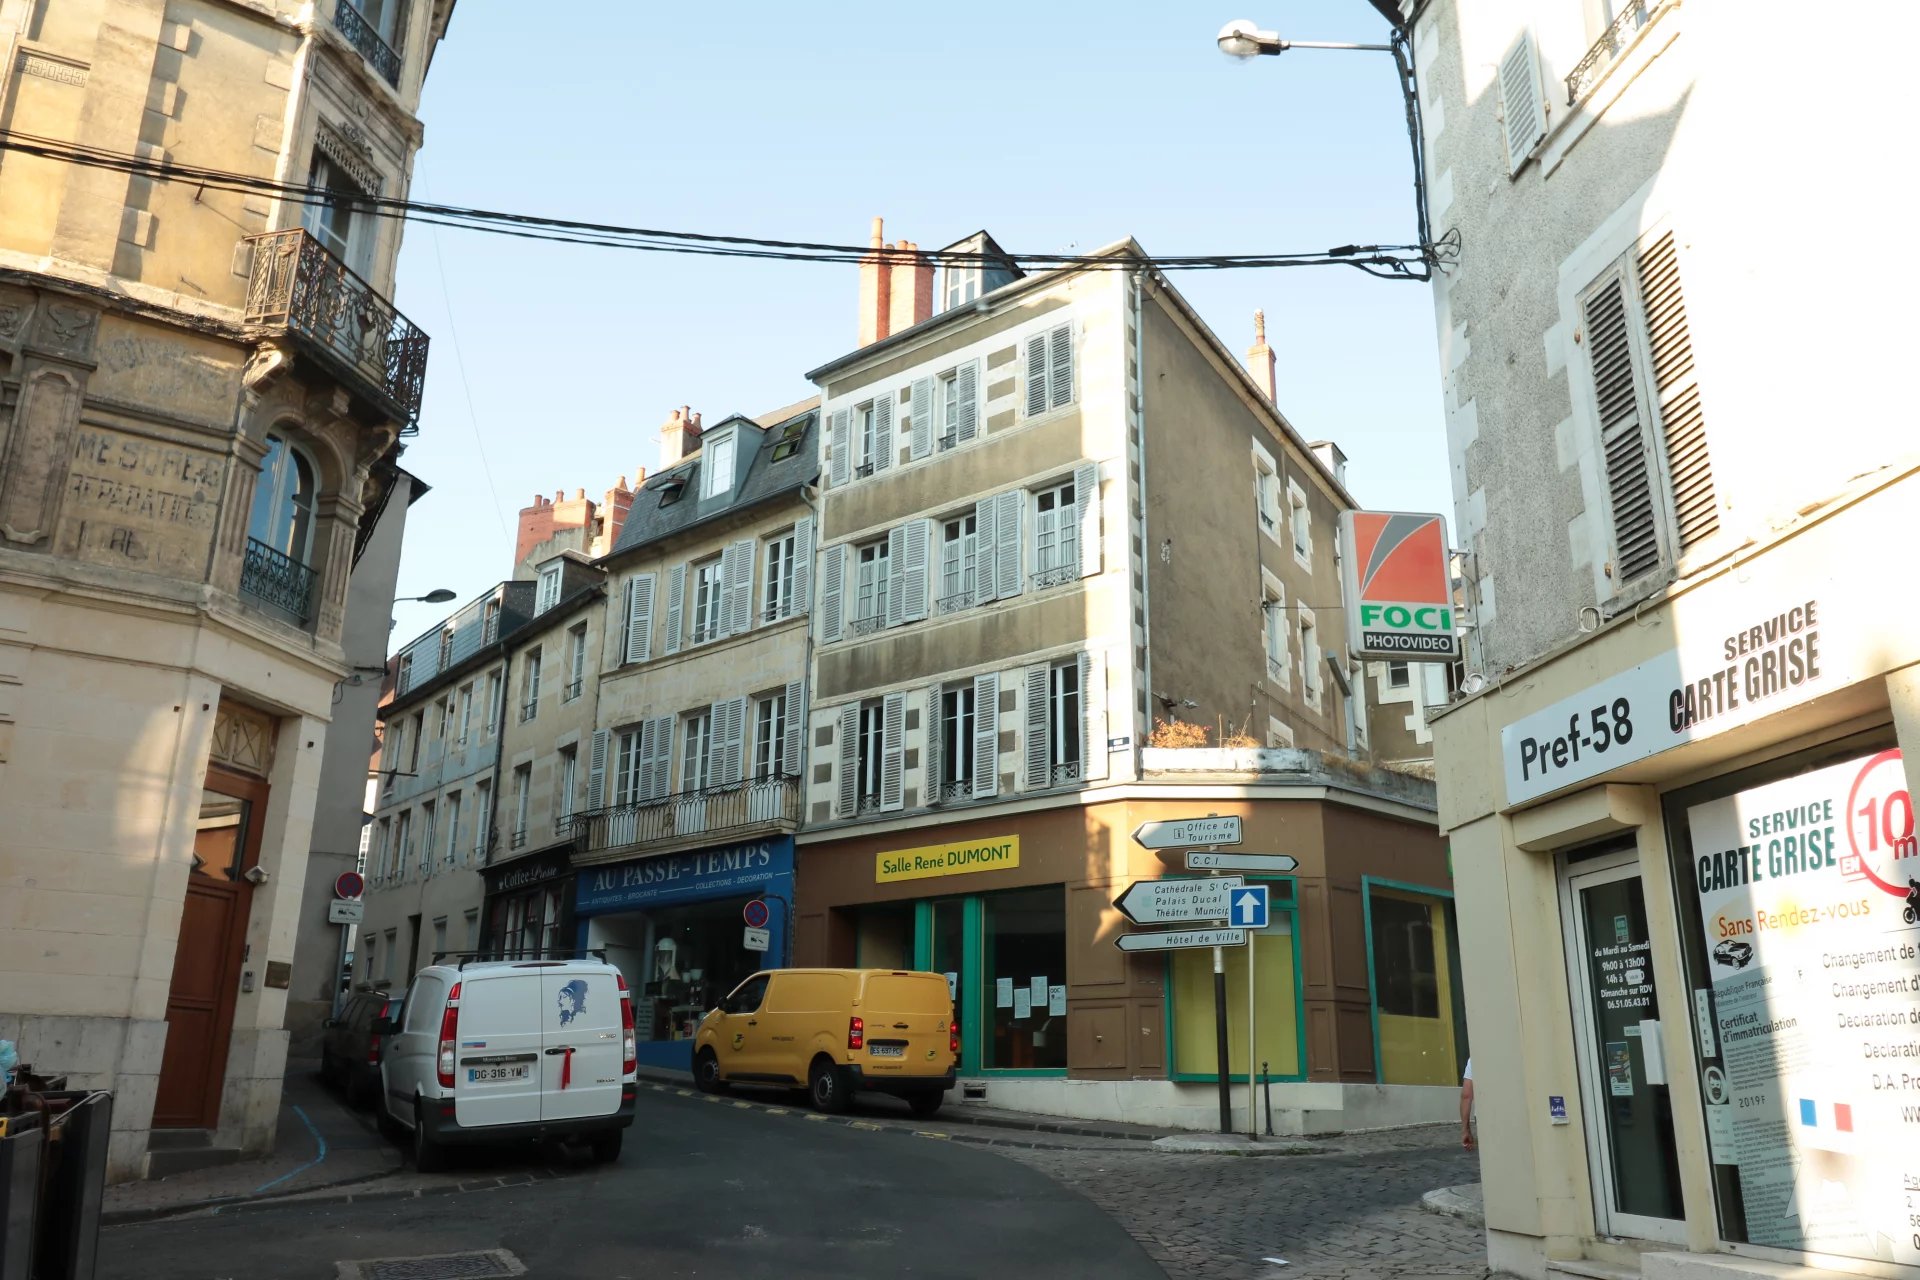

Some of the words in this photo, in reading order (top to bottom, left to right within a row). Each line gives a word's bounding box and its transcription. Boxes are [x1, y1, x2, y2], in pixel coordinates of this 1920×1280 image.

[1724, 600, 1818, 662] SERVICE
[1366, 635, 1449, 650] PHOTOVIDEO
[1669, 665, 1740, 733] CARTE
[1745, 630, 1821, 705] GRISE
[1520, 697, 1633, 781] Pref-58
[1187, 823, 1218, 832] Office
[1223, 821, 1235, 829] de
[1749, 799, 1833, 839] SERVICE
[1858, 789, 1915, 852] 10
[1188, 832, 1232, 842] Tourisme
[593, 868, 616, 891] AU
[623, 842, 771, 888] PASSE-TEMPS
[883, 857, 912, 874] Salle
[914, 854, 944, 870] René
[947, 844, 1012, 866] DUMONT
[1192, 856, 1221, 865] C.C.I.
[1699, 844, 1762, 893] CARTE
[1768, 826, 1836, 879] GRISE
[1843, 857, 1860, 871] EN
[695, 878, 732, 890] COLLECTIONS
[1154, 884, 1202, 894] Cathédrale
[627, 889, 658, 900] BROCANTE
[1155, 897, 1186, 906] Palais
[1192, 894, 1222, 904] Ducal
[1156, 909, 1188, 918] Théâtre
[1195, 907, 1229, 916] Municip
[1718, 915, 1753, 938] Sans
[1757, 899, 1870, 932] Rendez-vous
[1166, 935, 1193, 945] Hôtel
[1198, 934, 1210, 943] de
[1216, 933, 1240, 942] Ville
[1594, 948, 1602, 957] du
[1602, 945, 1620, 956] Mardi
[1628, 940, 1650, 952] Samedi
[1822, 946, 1897, 969] Changement
[1900, 943, 1915, 960] de
[1602, 961, 1618, 972] 9h00
[1619, 960, 1624, 969] à
[1624, 957, 1645, 968] 13h00
[1605, 974, 1618, 985] 14h
[1619, 973, 1624, 983] à
[1600, 987, 1628, 998] Dimanche
[1629, 987, 1638, 995] sur
[1639, 984, 1653, 993] RDV
[1832, 977, 1908, 1000] Changement
[1720, 1011, 1759, 1030] Certificat
[1723, 1017, 1797, 1043] d'immatriculation
[1863, 1040, 1920, 1059] Declarati
